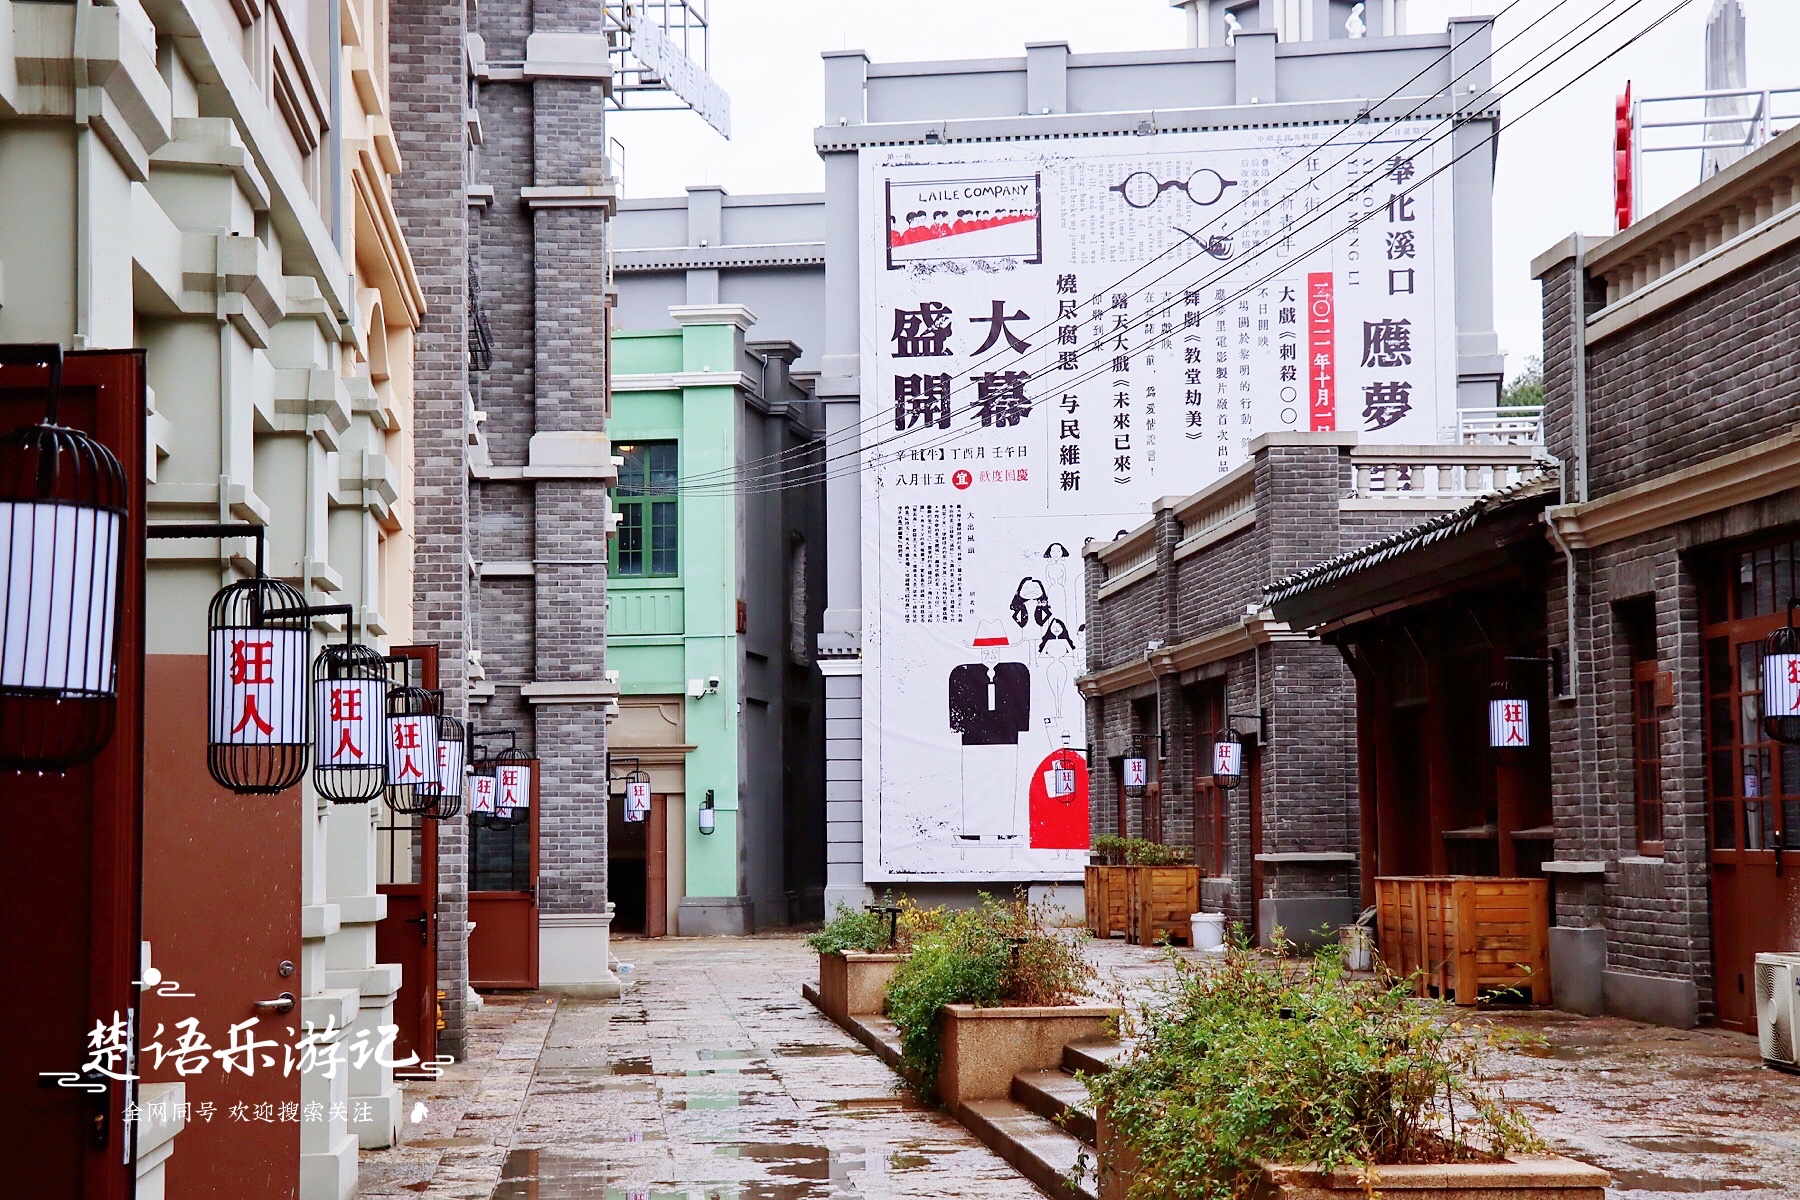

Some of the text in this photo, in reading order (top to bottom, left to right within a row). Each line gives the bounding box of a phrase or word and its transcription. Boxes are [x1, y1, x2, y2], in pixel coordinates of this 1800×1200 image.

[919, 184, 1029, 202] LAILE COMPANY
[1303, 157, 1321, 213] 狂人街
[1347, 157, 1360, 286] YING MENG LI
[1385, 156, 1416, 295] 奉化溪口
[1059, 393, 1081, 491] 与民維新
[230, 639, 275, 736] 狂人
[330, 688, 364, 759] 狂人
[1503, 703, 1524, 743] 狂人
[394, 723, 424, 779] 狂人
[1218, 744, 1231, 773] 狂人
[502, 769, 518, 804] 狂人
[1062, 771, 1072, 792] 狂人
[1131, 760, 1143, 784] 狂人
[477, 779, 492, 810] 狂人
[633, 785, 646, 809] 狂人
